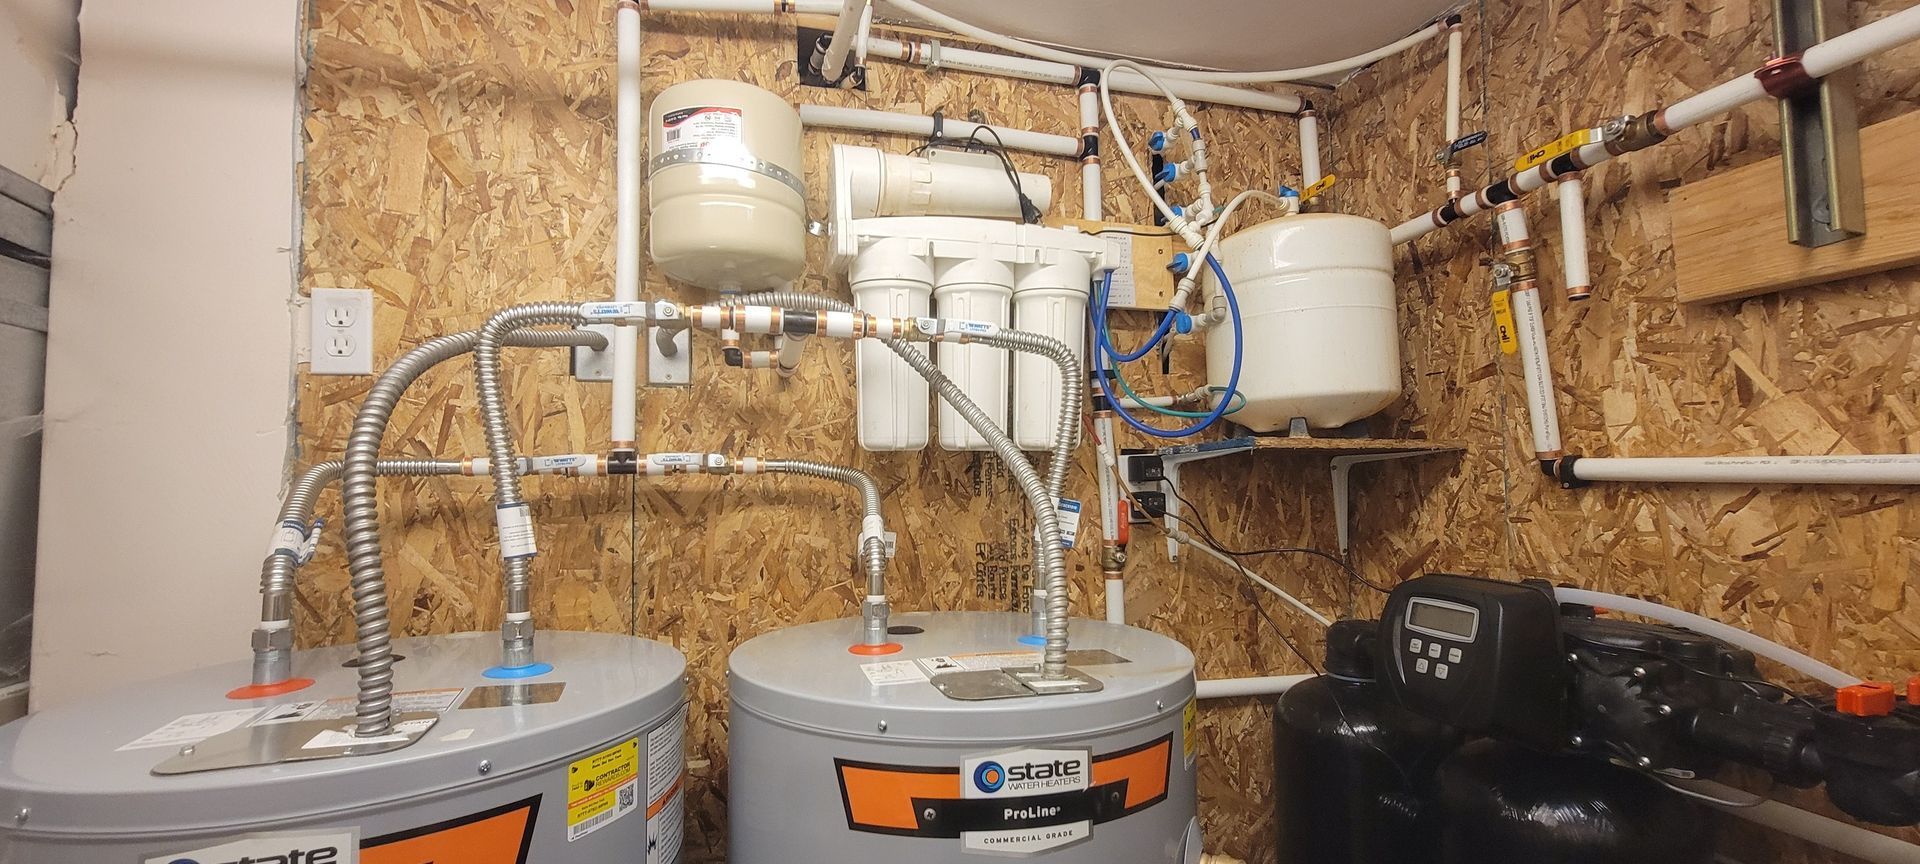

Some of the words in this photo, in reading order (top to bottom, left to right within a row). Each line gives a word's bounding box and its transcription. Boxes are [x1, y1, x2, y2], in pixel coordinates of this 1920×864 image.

[1022, 585, 1032, 613] Forc
[595, 761, 631, 781] CONTRACTOR
[1008, 760, 1080, 781] state
[1008, 781, 1040, 791] WATER
[1041, 776, 1081, 788] HEATERS
[984, 835, 1042, 844] COMMERCIAL
[1046, 830, 1073, 839] GRADE
